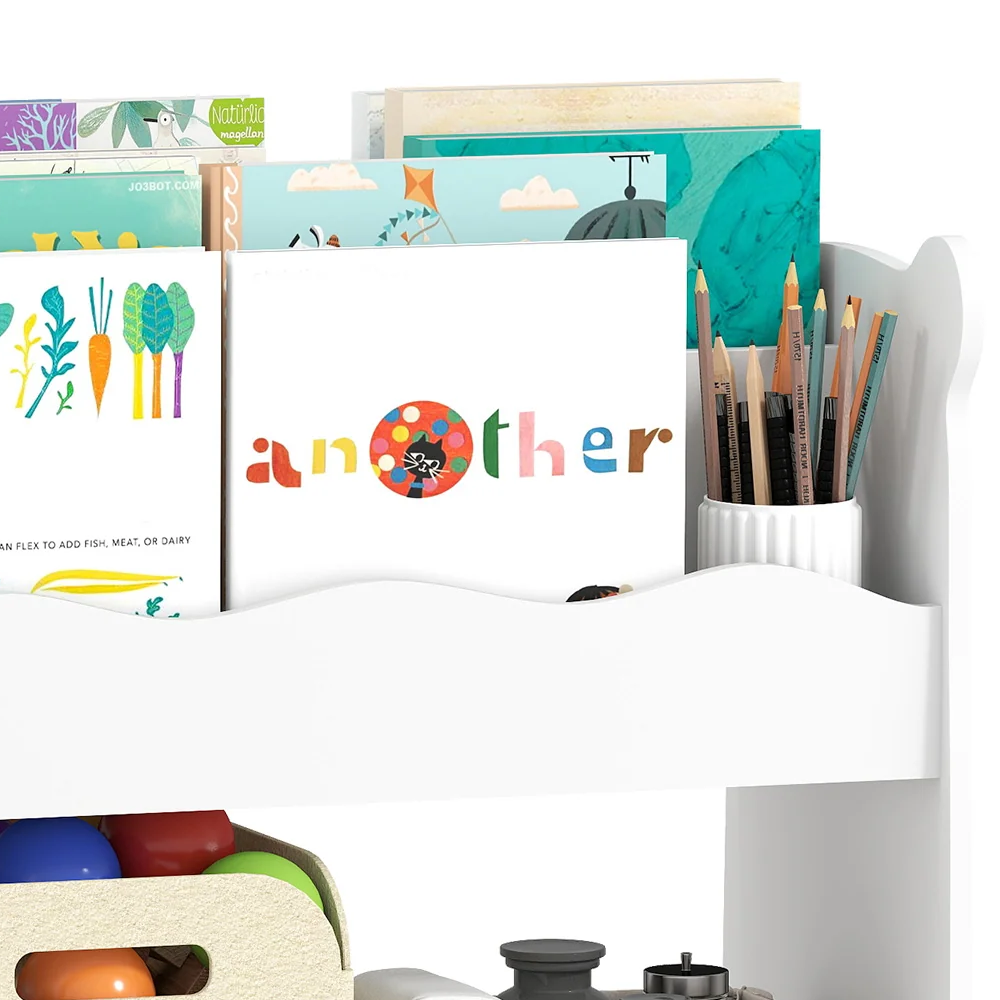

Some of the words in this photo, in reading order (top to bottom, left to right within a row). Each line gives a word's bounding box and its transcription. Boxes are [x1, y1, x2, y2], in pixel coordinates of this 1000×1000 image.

[220, 127, 264, 142] magellan
[128, 180, 200, 192] JO3BOT.COM
[16, 541, 40, 551] FLEX
[43, 541, 56, 550] TO
[59, 540, 81, 549] ADD
[84, 539, 109, 549] FISH,
[112, 537, 141, 548] MEAT,
[143, 537, 158, 547] OR
[162, 536, 191, 545] DAIRY
